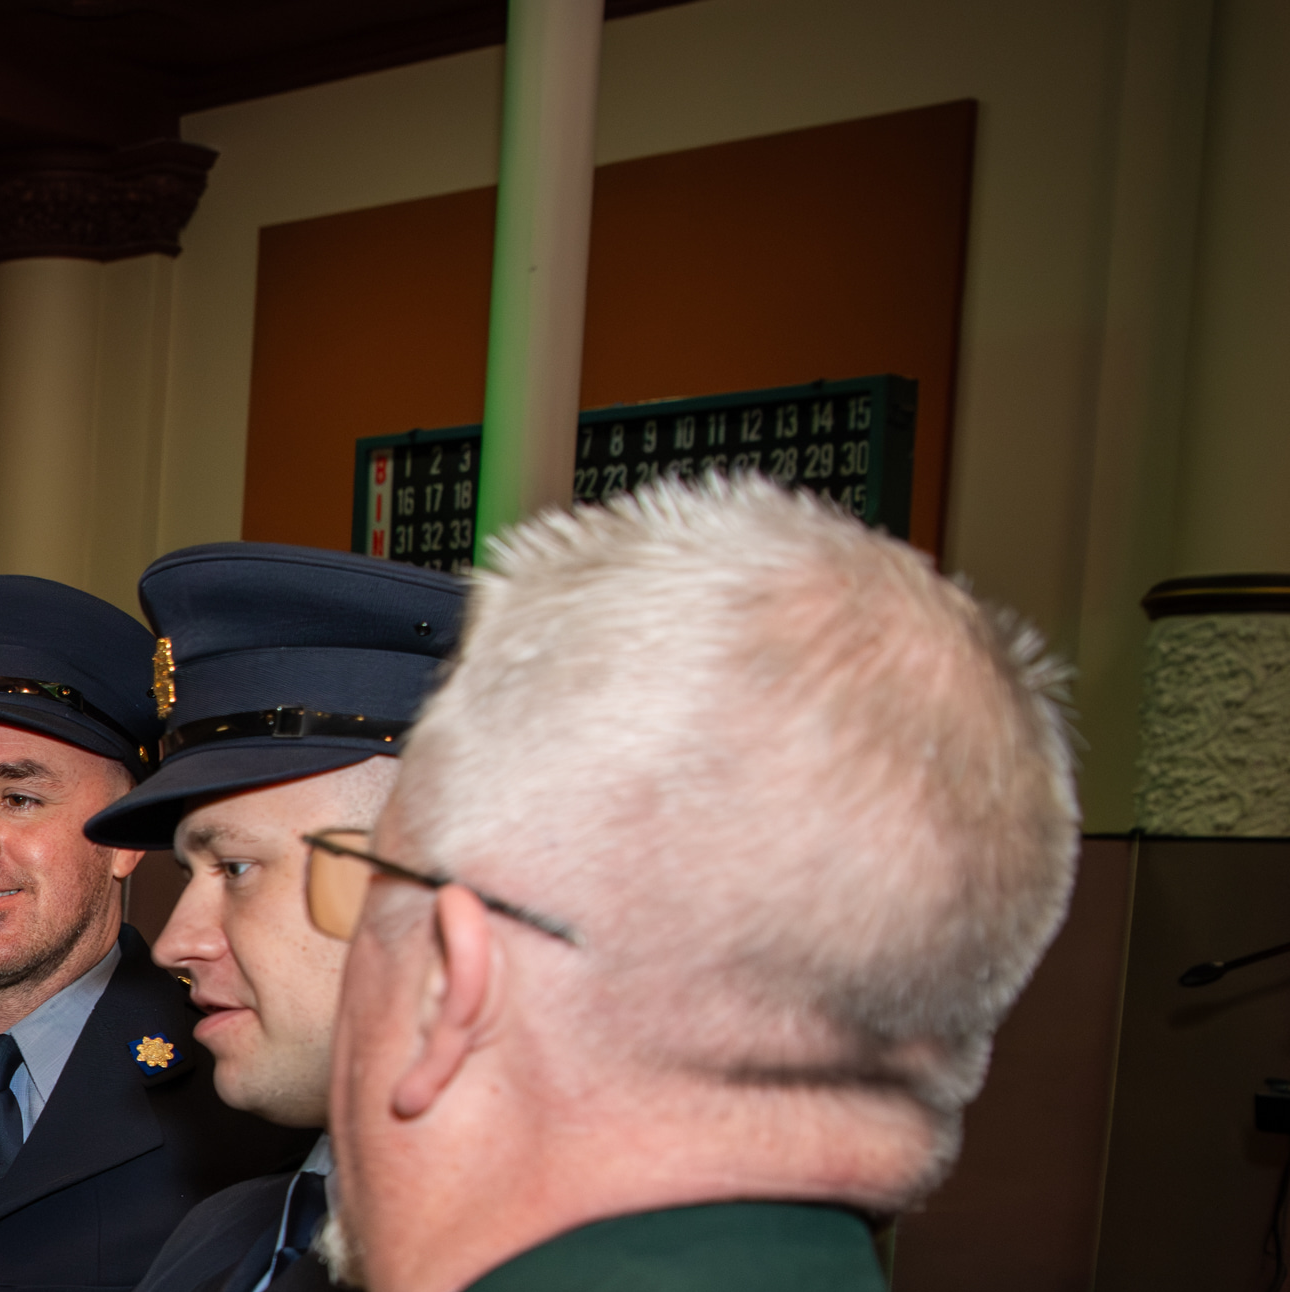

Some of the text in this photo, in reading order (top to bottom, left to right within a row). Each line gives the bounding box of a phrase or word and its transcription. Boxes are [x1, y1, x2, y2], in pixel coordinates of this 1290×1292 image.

[375, 456, 387, 485] B
[429, 444, 444, 476] 2
[458, 442, 472, 474] 3
[581, 427, 594, 459] 7
[609, 423, 625, 457] 8
[642, 420, 658, 455] 9
[673, 416, 696, 450] 10
[708, 412, 728, 447] 11
[740, 408, 764, 443] 12
[775, 403, 799, 439] 13
[810, 399, 835, 435] 14
[846, 395, 871, 431] 15
[396, 485, 416, 516] 16
[424, 482, 444, 513] 17
[453, 479, 473, 510] 18
[804, 442, 835, 479] 29
[839, 440, 869, 476] 30
[394, 523, 415, 555] 31
[419, 519, 444, 553] 32
[448, 517, 472, 550] 33
